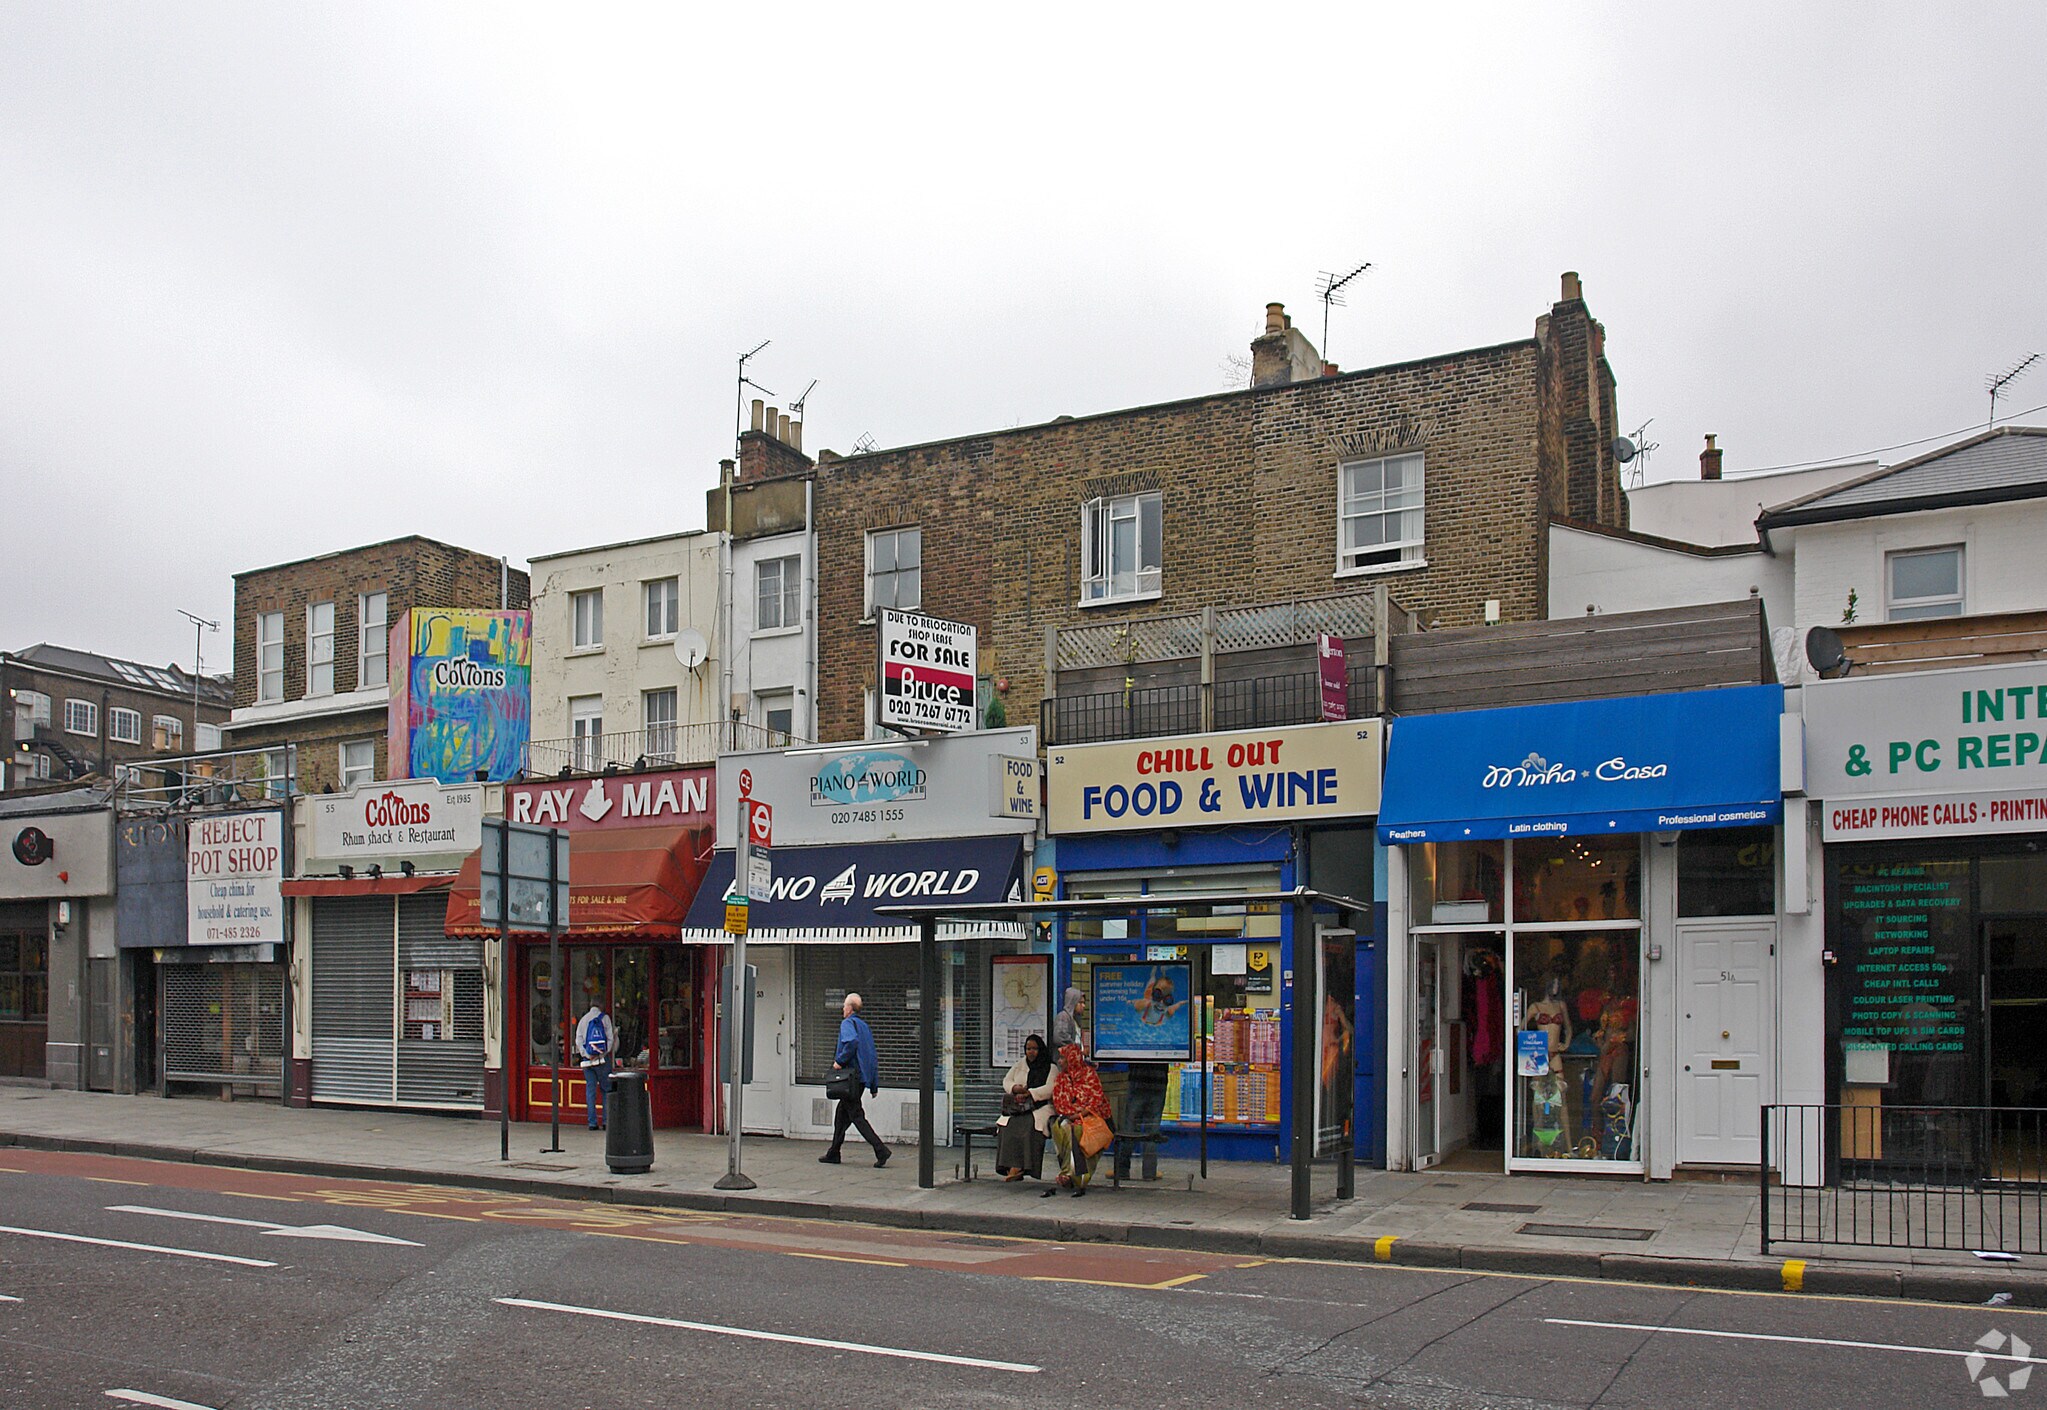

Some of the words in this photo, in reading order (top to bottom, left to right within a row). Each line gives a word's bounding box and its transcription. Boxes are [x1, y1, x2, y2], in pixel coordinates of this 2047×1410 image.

[888, 612, 904, 624] DUE
[906, 615, 919, 627] TO
[921, 618, 972, 636] RELOCATION
[908, 629, 931, 641] SHOP
[932, 632, 953, 646] LEASE
[890, 640, 929, 662] FOR
[934, 647, 970, 668] SALE
[901, 666, 961, 705] Bruce
[889, 699, 911, 715] 020
[914, 702, 942, 719] 7267
[945, 706, 971, 724] 6772
[1020, 737, 1029, 745] 53
[1357, 731, 1368, 740] 52
[1055, 756, 1065, 765] 52
[1136, 746, 1214, 775] CHILL
[1227, 739, 1283, 767] OUT
[1844, 744, 1872, 777] &
[1889, 739, 1941, 774] PC
[1958, 732, 2047, 770] REP
[1007, 761, 1033, 777] FOOD
[1483, 762, 1576, 788] Minha
[1595, 757, 1668, 782] Casa
[741, 773, 751, 790] CE
[810, 775, 855, 793] PIANO
[869, 769, 927, 789] WORLD
[1016, 782, 1024, 795] &
[456, 794, 471, 804] 1985
[513, 788, 575, 824] RAY
[621, 776, 708, 818] MAN
[1083, 779, 1183, 820] FOOD
[1199, 777, 1221, 812] &
[1238, 768, 1337, 810] WINE
[325, 804, 335, 813] 55
[1009, 797, 1034, 813] WINE
[831, 811, 850, 824] 020
[852, 810, 877, 823] 7485
[880, 808, 904, 821] 1555
[1658, 812, 1717, 826] Professional
[1718, 809, 1767, 822] cosmetics
[1833, 807, 1877, 831] CHEAP
[1882, 805, 1929, 827] PHONE
[1933, 802, 1977, 824] CALLS
[202, 817, 265, 845] REJECT
[1389, 829, 1427, 840] Feathers
[1509, 823, 1531, 833] Latin
[1533, 822, 1568, 832] clothing
[342, 831, 365, 847] Rhum
[367, 829, 393, 846] shack
[408, 827, 456, 844] Restaurant
[191, 850, 222, 874] POT
[228, 847, 278, 873] SHOP
[1892, 867, 1925, 876] REPAIRS
[210, 883, 227, 899] Cheap
[228, 882, 245, 896] china
[245, 881, 255, 896] for
[862, 869, 980, 899] WORLD
[1854, 883, 1901, 893] MACINTOSH
[1903, 882, 1950, 892] SPECIALIST
[577, 896, 589, 904] FOR
[591, 895, 606, 904] SALE
[613, 895, 628, 904] HIRE
[1843, 900, 1885, 909] UPGRADES
[1887, 899, 1893, 908] &
[1896, 899, 1916, 908] DATA
[1918, 898, 1961, 908] RECOVERY
[197, 903, 225, 920] household
[226, 904, 231, 919] &
[233, 903, 258, 921] catering
[260, 904, 272, 917] use.
[1876, 915, 1885, 924] IT
[1886, 914, 1928, 924] SOURCING
[206, 927, 238, 940] 071-485
[240, 925, 261, 938] 2326
[1874, 930, 1929, 939] NETWORKING
[1868, 946, 1899, 955] LAPTOP
[1901, 946, 1935, 955] REPAIRS
[1099, 971, 1122, 980] FREE
[1857, 963, 1896, 972] INTERNET
[1898, 963, 1930, 972] ACCESS
[1932, 963, 1947, 973] 50p
[1864, 979, 1891, 988] CHEAP
[1893, 979, 1911, 988] INTL
[1913, 979, 1939, 988] CALLS
[756, 990, 764, 998] 53
[1853, 995, 1886, 1004] COLOUR
[1887, 995, 1914, 1004] LASER
[1915, 995, 1955, 1004] PRINTING
[1852, 1011, 1879, 1020] PHOTO
[1881, 1011, 1902, 1020] COPY
[1913, 1010, 1956, 1019] SCANNING
[1844, 1027, 1874, 1036] MOBILE
[1876, 1027, 1892, 1036] TOP
[1894, 1026, 1910, 1036] UPS
[1920, 1026, 1936, 1035] SIM
[1937, 1026, 1965, 1035] CARDS
[1846, 1042, 1897, 1051] DISCOUNTED
[1900, 1042, 1934, 1051] CALLING
[1936, 1042, 1964, 1051] CARDS
